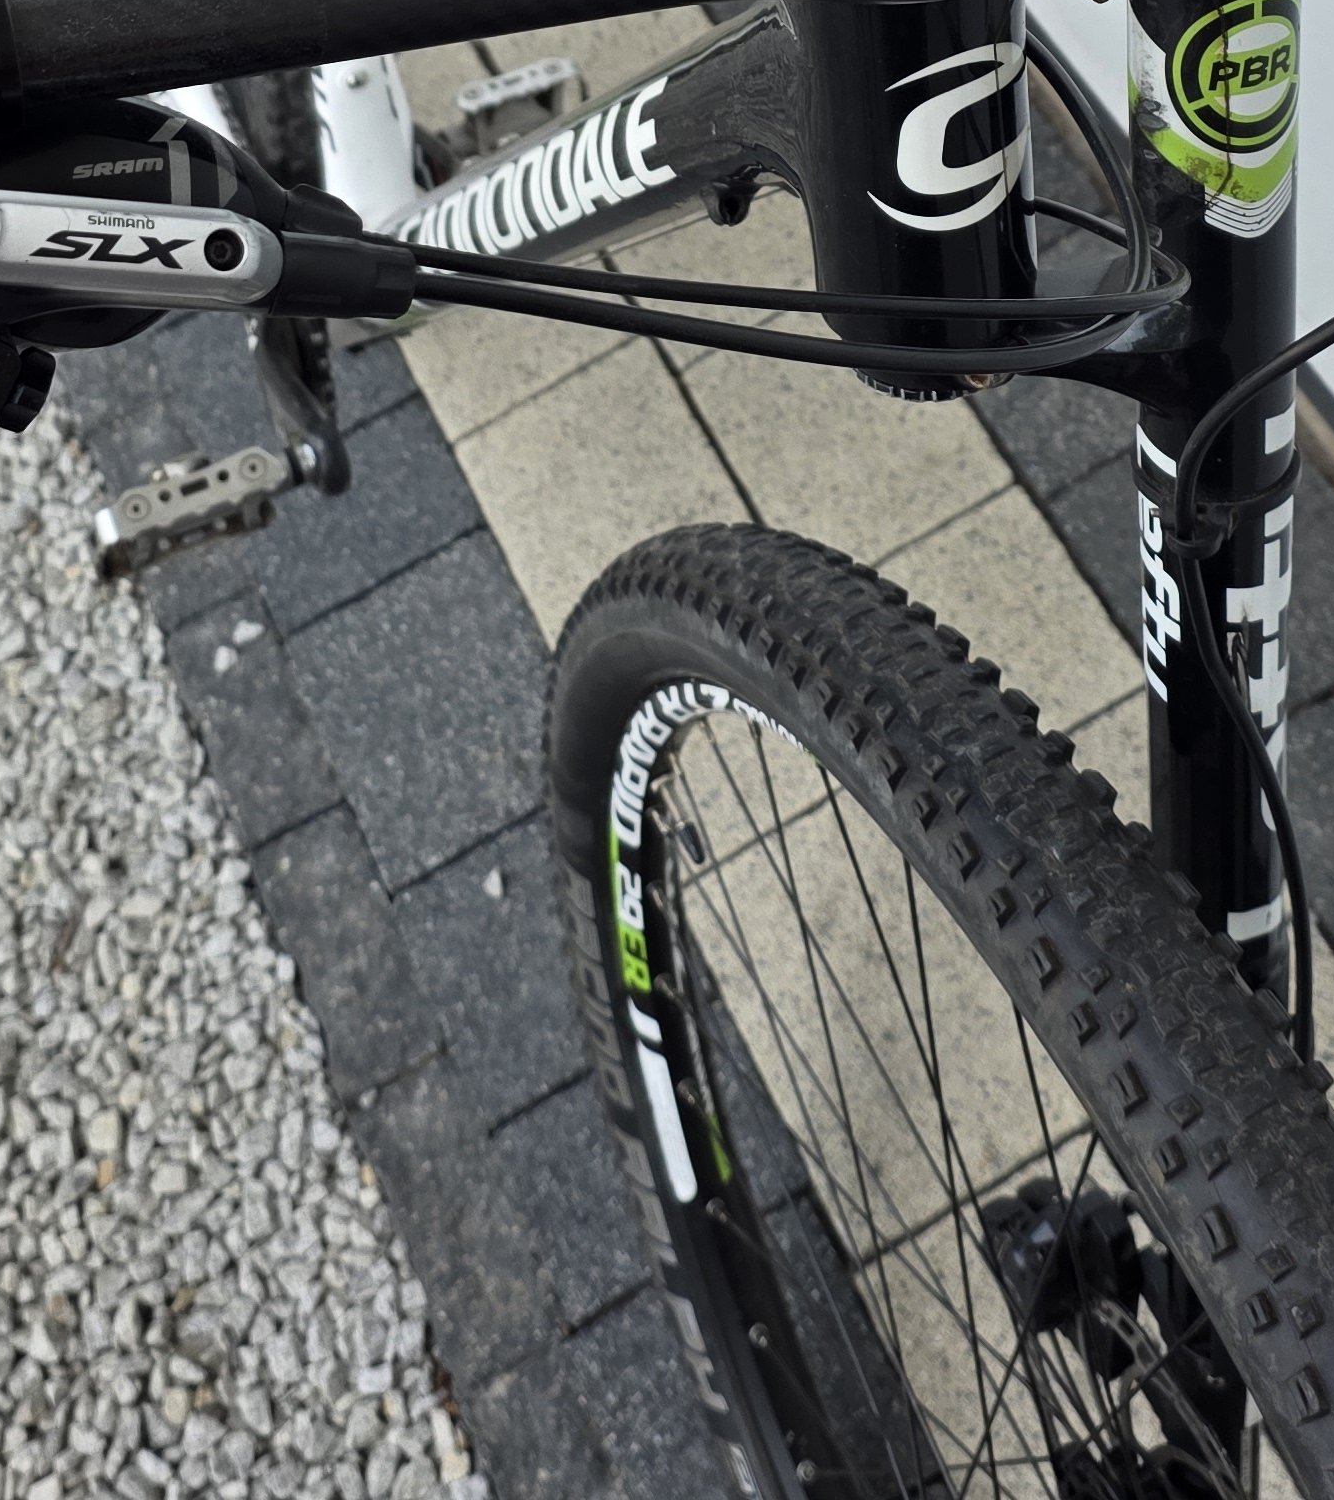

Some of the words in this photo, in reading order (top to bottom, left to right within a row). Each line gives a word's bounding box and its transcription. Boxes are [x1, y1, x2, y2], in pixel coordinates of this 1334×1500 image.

[1208, 44, 1291, 92] PBR
[72, 157, 164, 179] SRAM
[87, 214, 156, 230] SHIMANO
[29, 230, 196, 269] SLX
[610, 698, 674, 849] RAPID
[615, 861, 652, 993] 29ER
